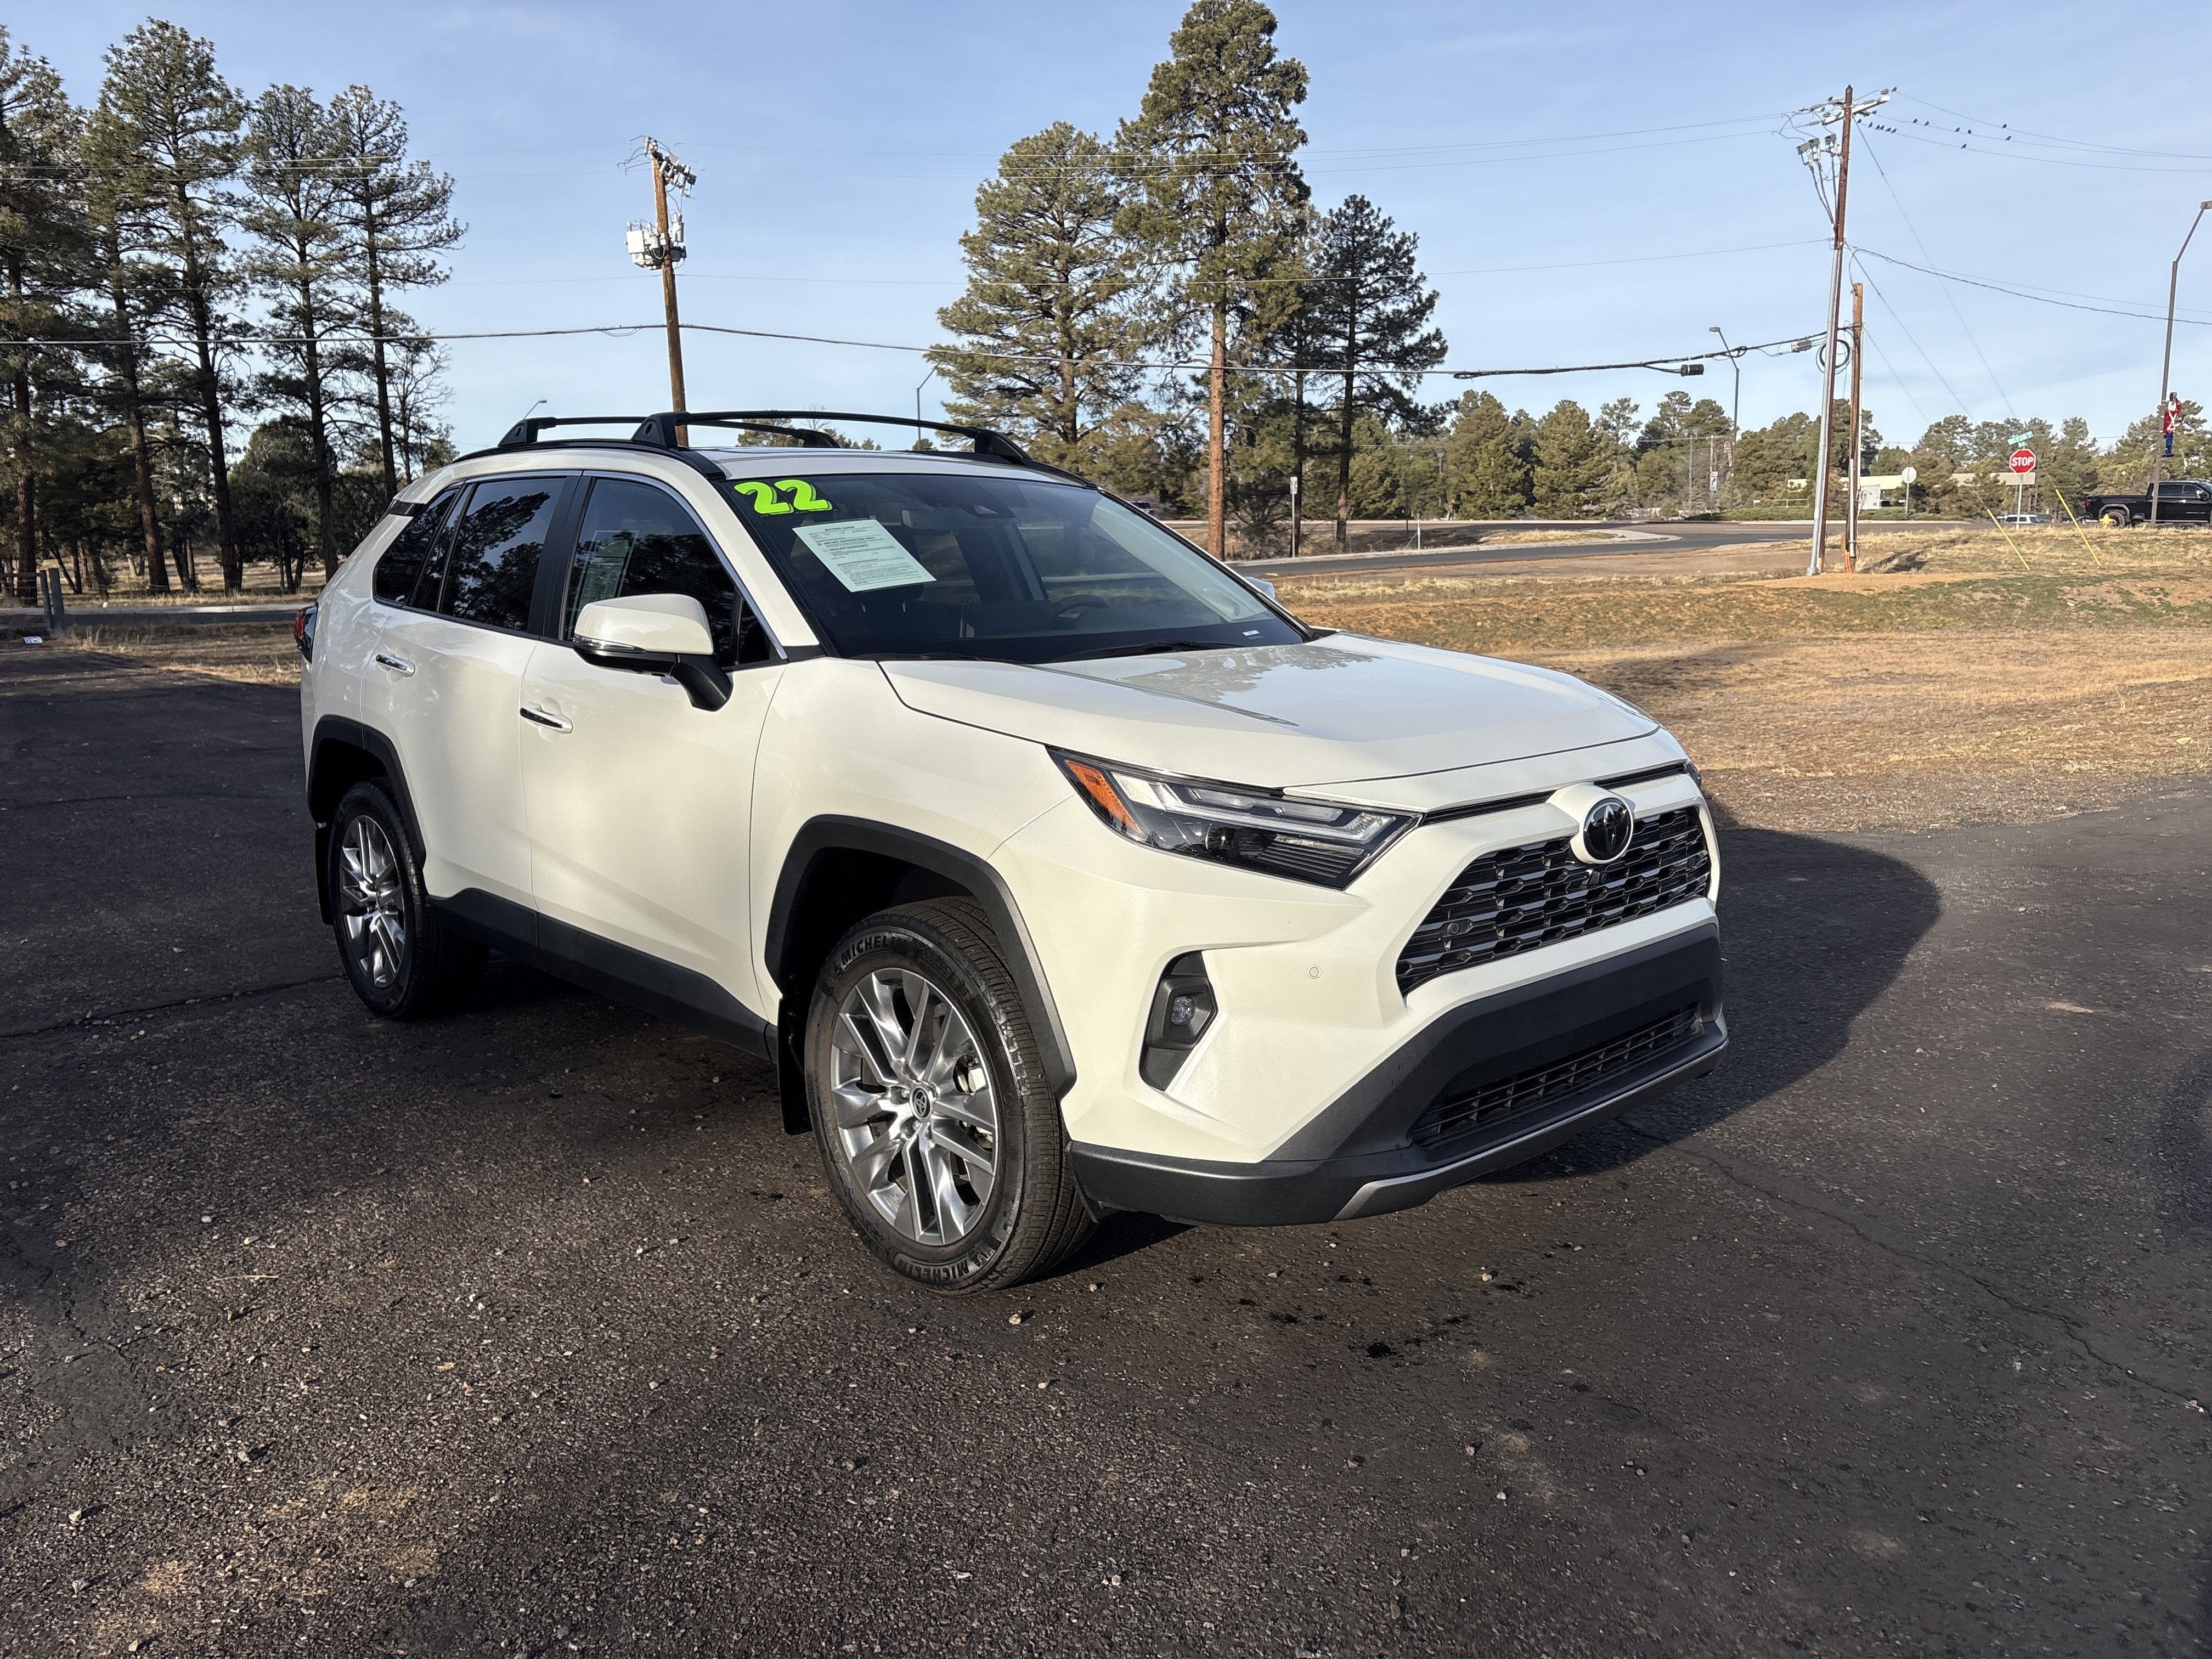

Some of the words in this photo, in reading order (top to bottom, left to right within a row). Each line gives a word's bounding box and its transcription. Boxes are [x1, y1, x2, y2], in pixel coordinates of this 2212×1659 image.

[2012, 456, 2034, 467] STOP
[734, 479, 833, 515] 22
[898, 1260, 970, 1282] MICHELIN
